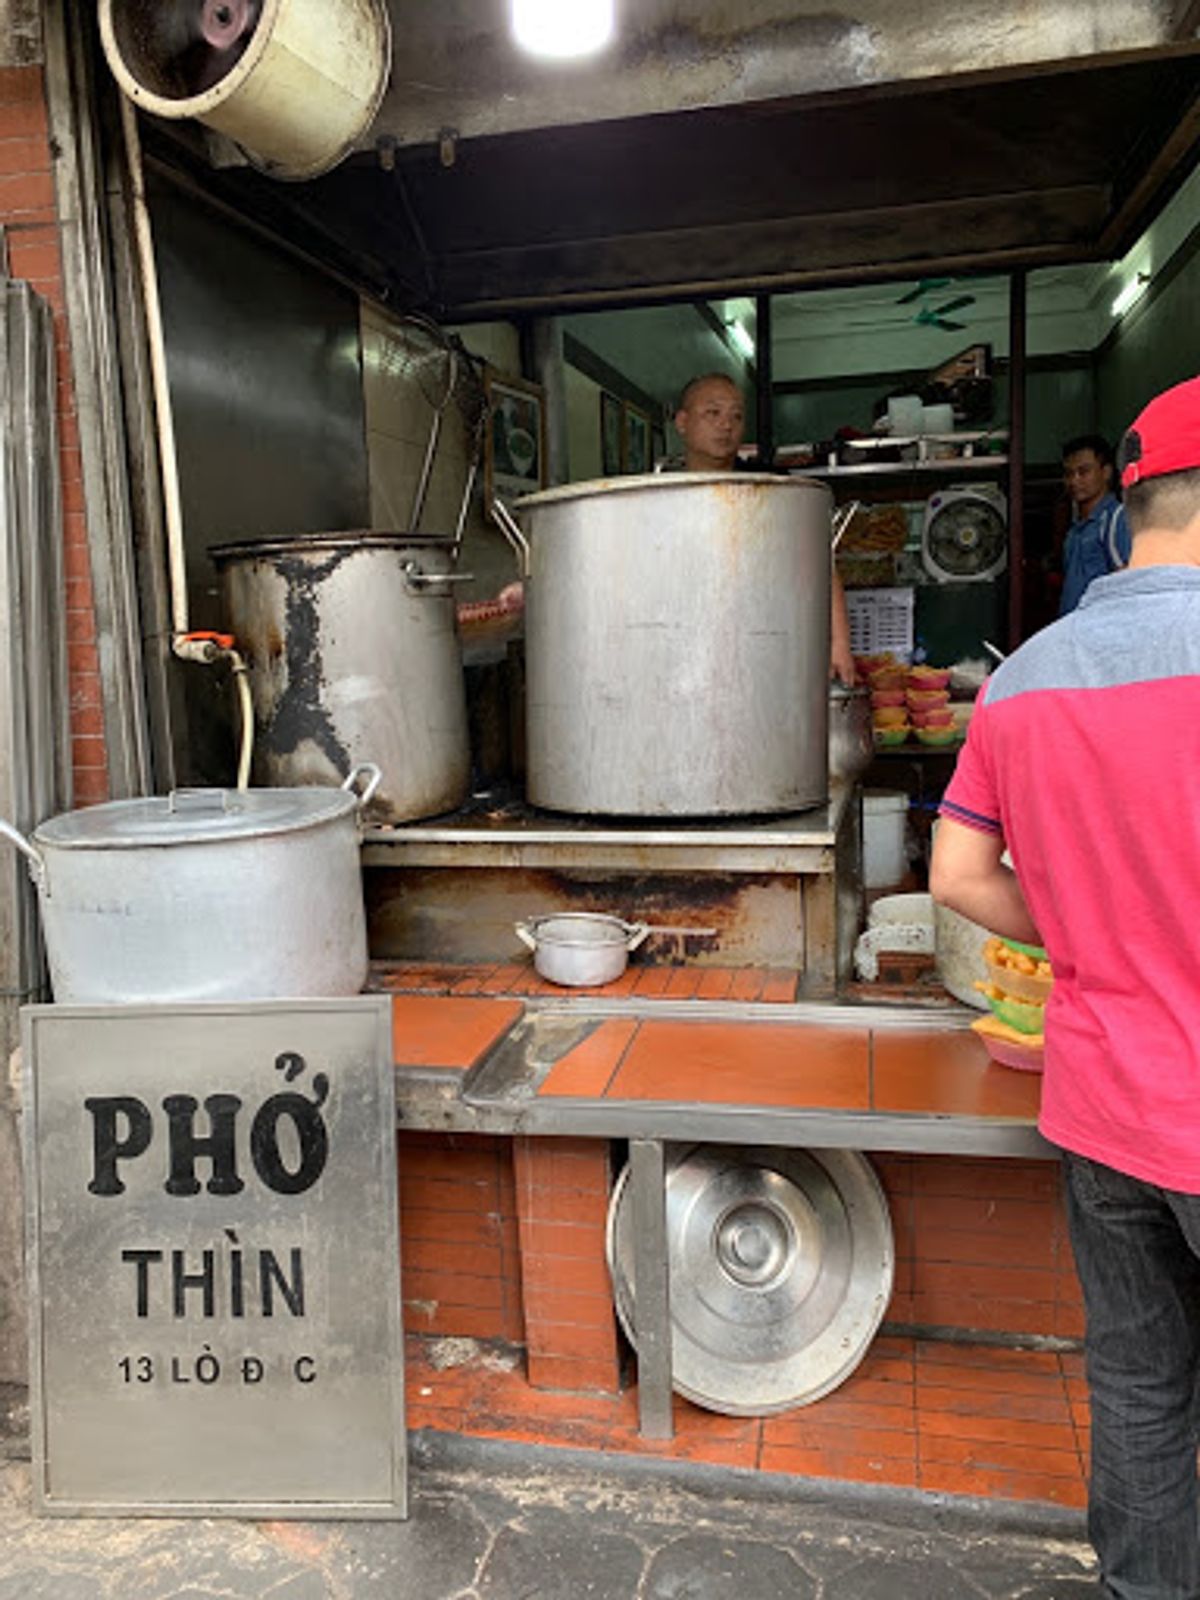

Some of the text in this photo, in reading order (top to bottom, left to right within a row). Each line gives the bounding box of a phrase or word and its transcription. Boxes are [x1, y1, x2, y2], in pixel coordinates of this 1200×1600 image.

[84, 1053, 329, 1196] PHỞ
[121, 1228, 305, 1318] THÌN
[117, 1356, 154, 1384] 13
[172, 1344, 220, 1385] LÒ
